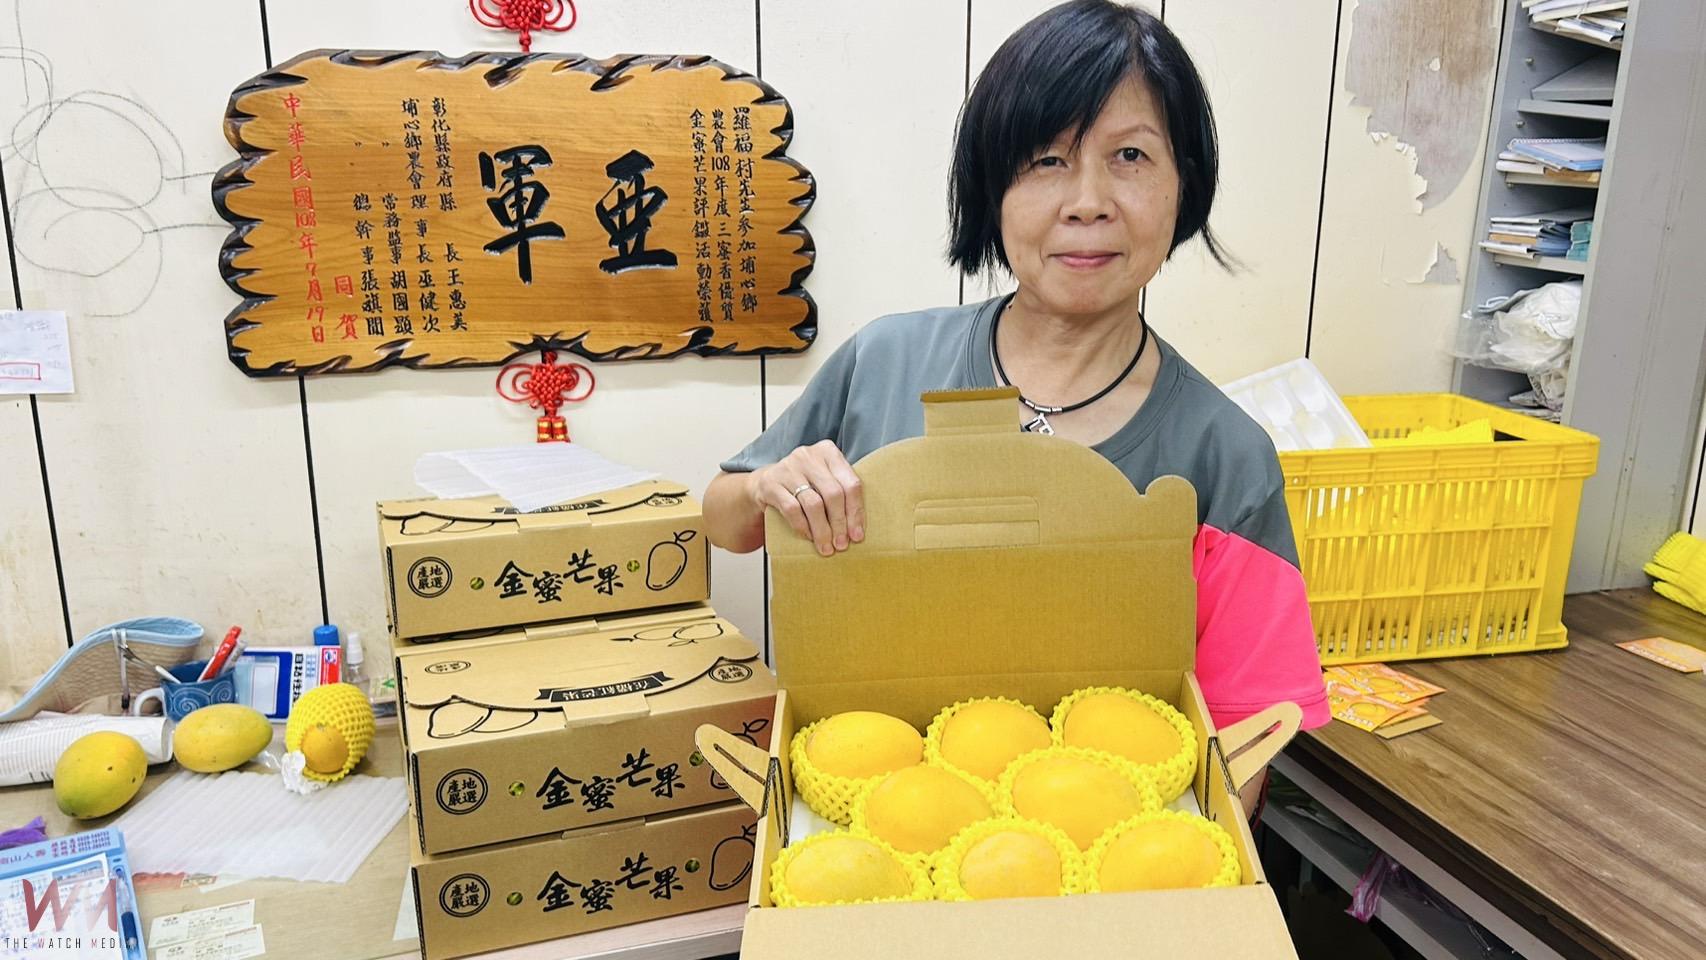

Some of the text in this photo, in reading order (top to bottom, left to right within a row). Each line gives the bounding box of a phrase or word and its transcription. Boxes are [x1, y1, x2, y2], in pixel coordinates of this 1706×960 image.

[494, 549, 624, 604] 金蜜芒果
[536, 748, 685, 813] 金蜜芒果
[536, 852, 684, 915] 金蜜芒果
